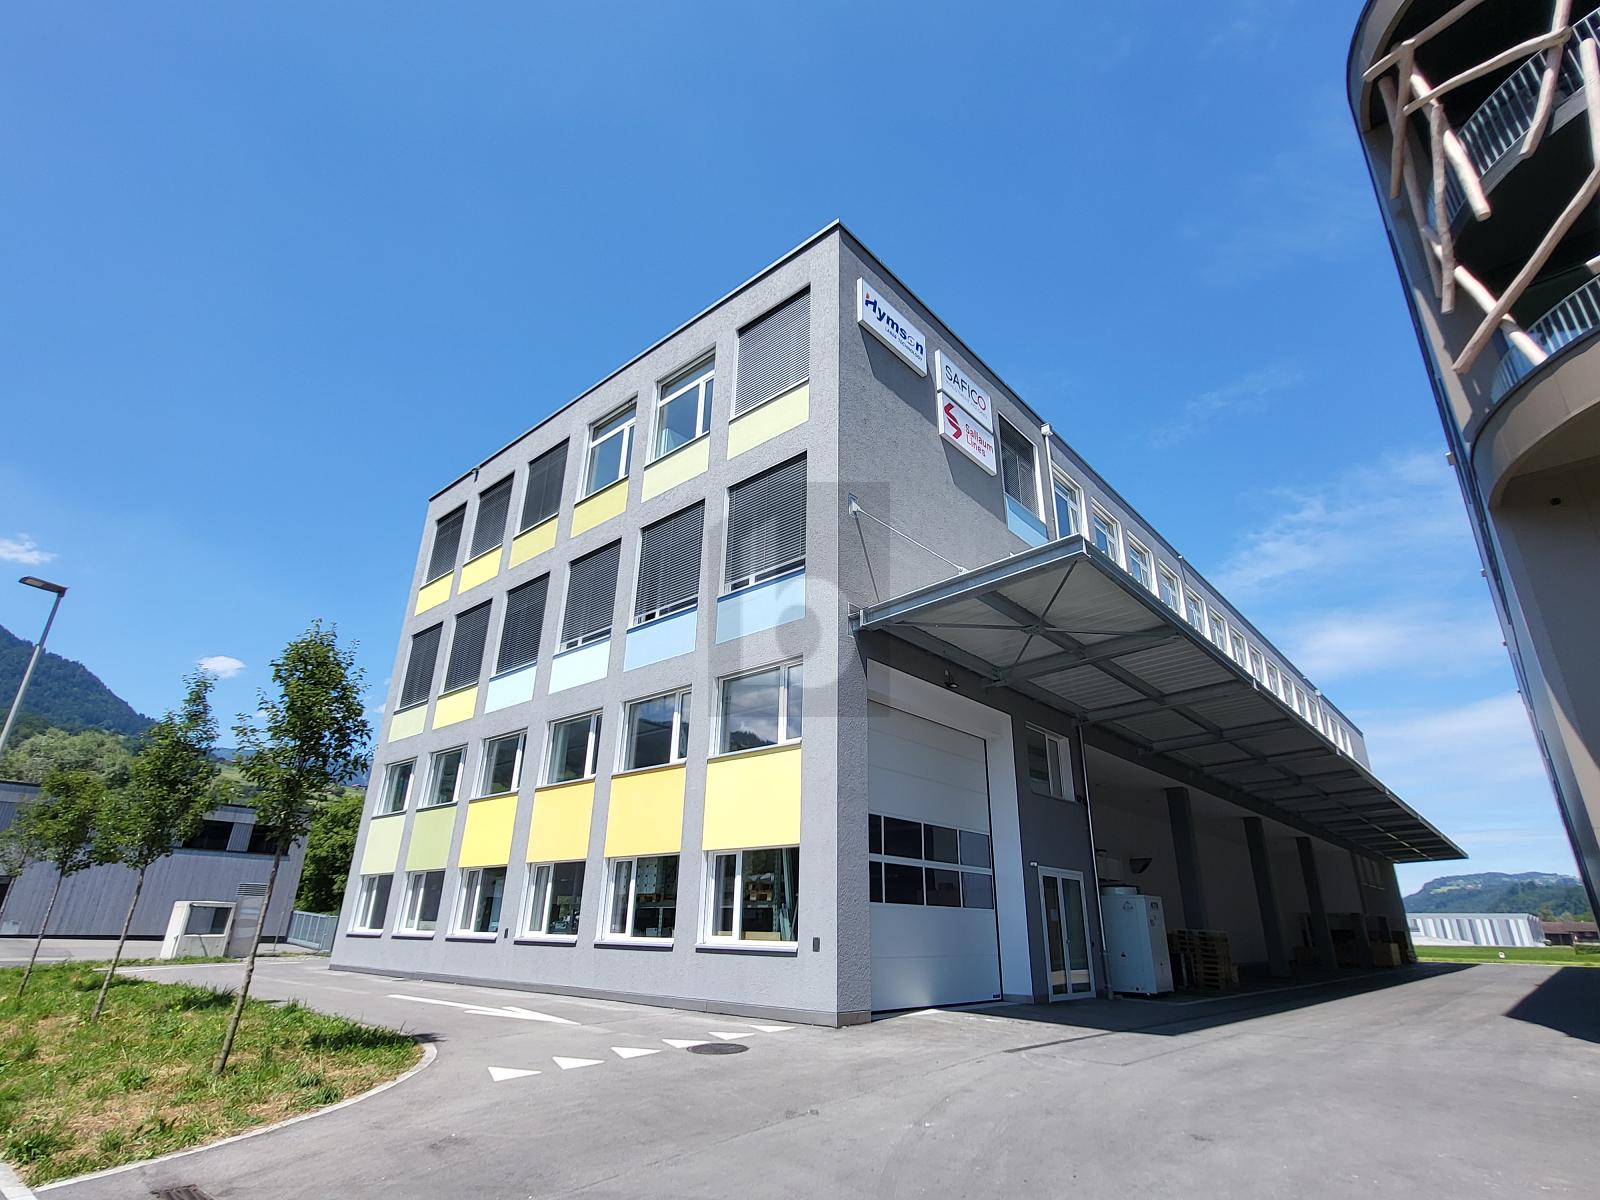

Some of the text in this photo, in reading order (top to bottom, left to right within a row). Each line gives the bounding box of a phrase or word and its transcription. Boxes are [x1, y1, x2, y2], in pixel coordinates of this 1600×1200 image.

[865, 292, 924, 355] Hymson
[945, 365, 987, 411] SAFICO
[965, 423, 994, 454] Sallaum
[966, 434, 986, 457] Lines
